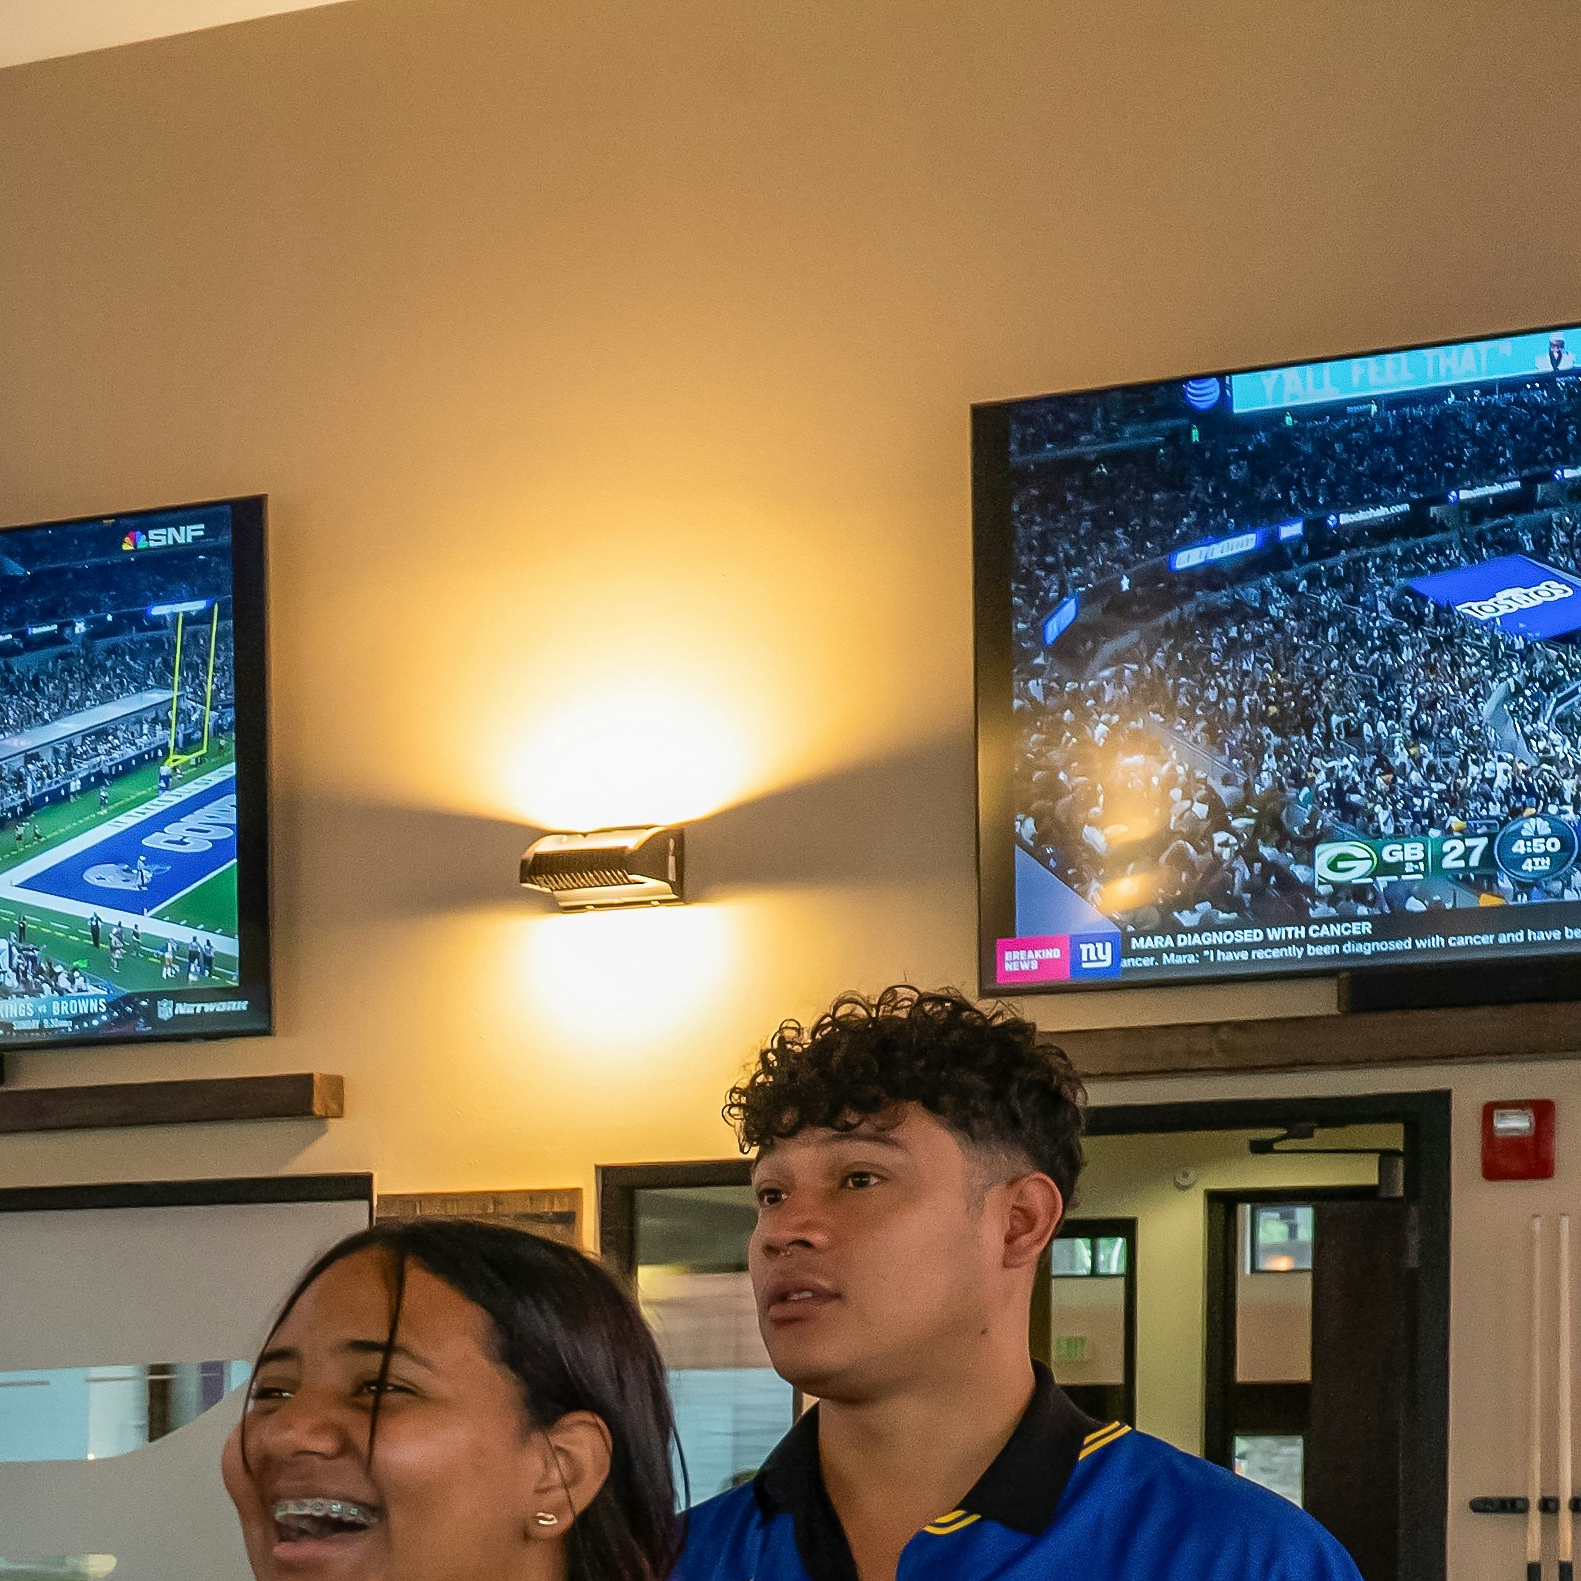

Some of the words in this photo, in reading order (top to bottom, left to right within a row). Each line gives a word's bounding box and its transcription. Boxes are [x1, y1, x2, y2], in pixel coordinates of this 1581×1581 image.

[1350, 354, 1416, 386] FEEL
[148, 523, 205, 547] SNF
[1381, 841, 1425, 863] GB
[1441, 836, 1489, 869] 27
[1511, 836, 1562, 855] 4:50
[1521, 857, 1551, 873] 4TH
[1131, 934, 1178, 950] MARA
[1178, 929, 1264, 948] DIAGNOSED
[1266, 925, 1306, 941] WITH
[1308, 921, 1373, 938] CANCER
[1162, 952, 1200, 966] Mara:
[1216, 948, 1249, 962] have
[1251, 944, 1304, 961] recently
[1306, 943, 1340, 957] been
[1342, 937, 1412, 957] diagnosed
[1415, 934, 1445, 950] with
[1447, 933, 1494, 948] cancer
[1497, 929, 1524, 944] and
[1527, 927, 1562, 943] have
[52, 998, 108, 1016] BROWNS
